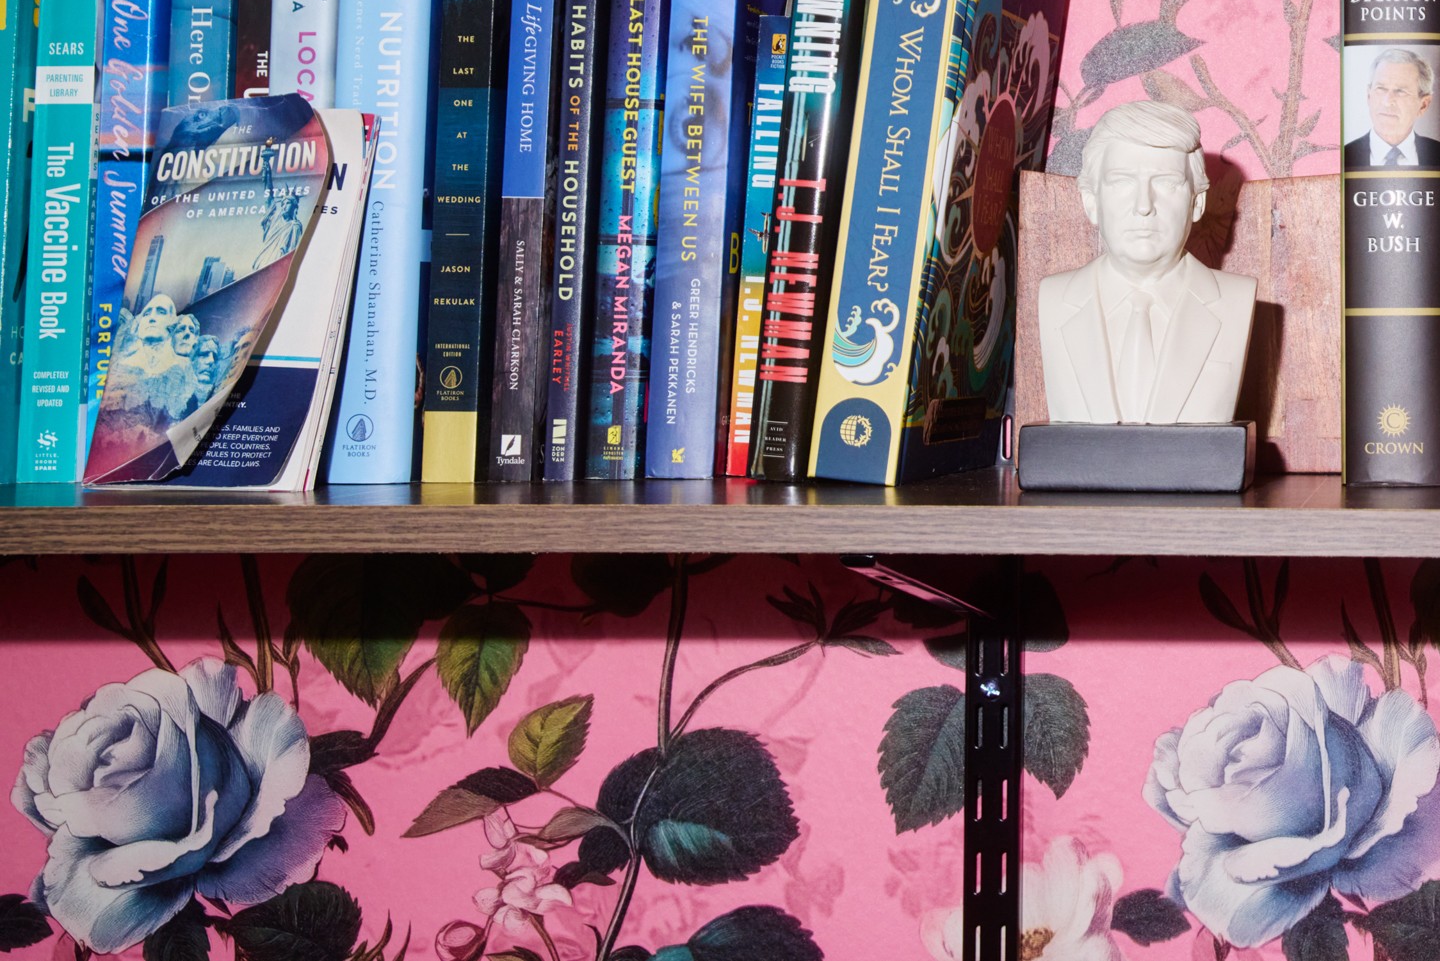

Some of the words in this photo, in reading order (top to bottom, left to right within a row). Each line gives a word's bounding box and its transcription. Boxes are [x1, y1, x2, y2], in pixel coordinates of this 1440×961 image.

[1360, 7, 1427, 21] POINTS
[49, 42, 84, 55] SEARS
[569, 5, 587, 89] HABITS
[692, 15, 708, 57] THE
[46, 72, 84, 83] PARENTING
[453, 67, 474, 75] LAST
[624, 53, 642, 122] HOUSE
[688, 64, 706, 115] WIFE
[889, 26, 925, 116] WHOM
[49, 88, 79, 97] LIBRARY
[46, 142, 74, 178] The
[208, 204, 266, 218] AMERICA
[437, 196, 481, 204] WEDDING
[1353, 191, 1435, 207] GEORGE
[42, 183, 81, 284] Vaccine
[370, 200, 385, 277] Catherine
[557, 159, 579, 301] HOUSEHOLD
[1367, 237, 1420, 253] BUSH
[440, 265, 471, 273] JASON
[615, 215, 633, 289] MEGAN
[38, 291, 68, 340] Book
[433, 298, 475, 306] REKULAK
[688, 278, 700, 322] GREER
[363, 283, 381, 362] Shanahan,
[669, 313, 682, 356] SARAH
[509, 328, 522, 391] CLARKSON
[609, 296, 629, 396] MIRANDA
[685, 325, 699, 395] HENDRICKS
[33, 371, 69, 379] COMPLETELY
[363, 368, 377, 405] M.D.
[666, 359, 680, 425] PEKKANEN
[496, 456, 525, 466] Tyndale
[1364, 442, 1424, 456] CROWN
